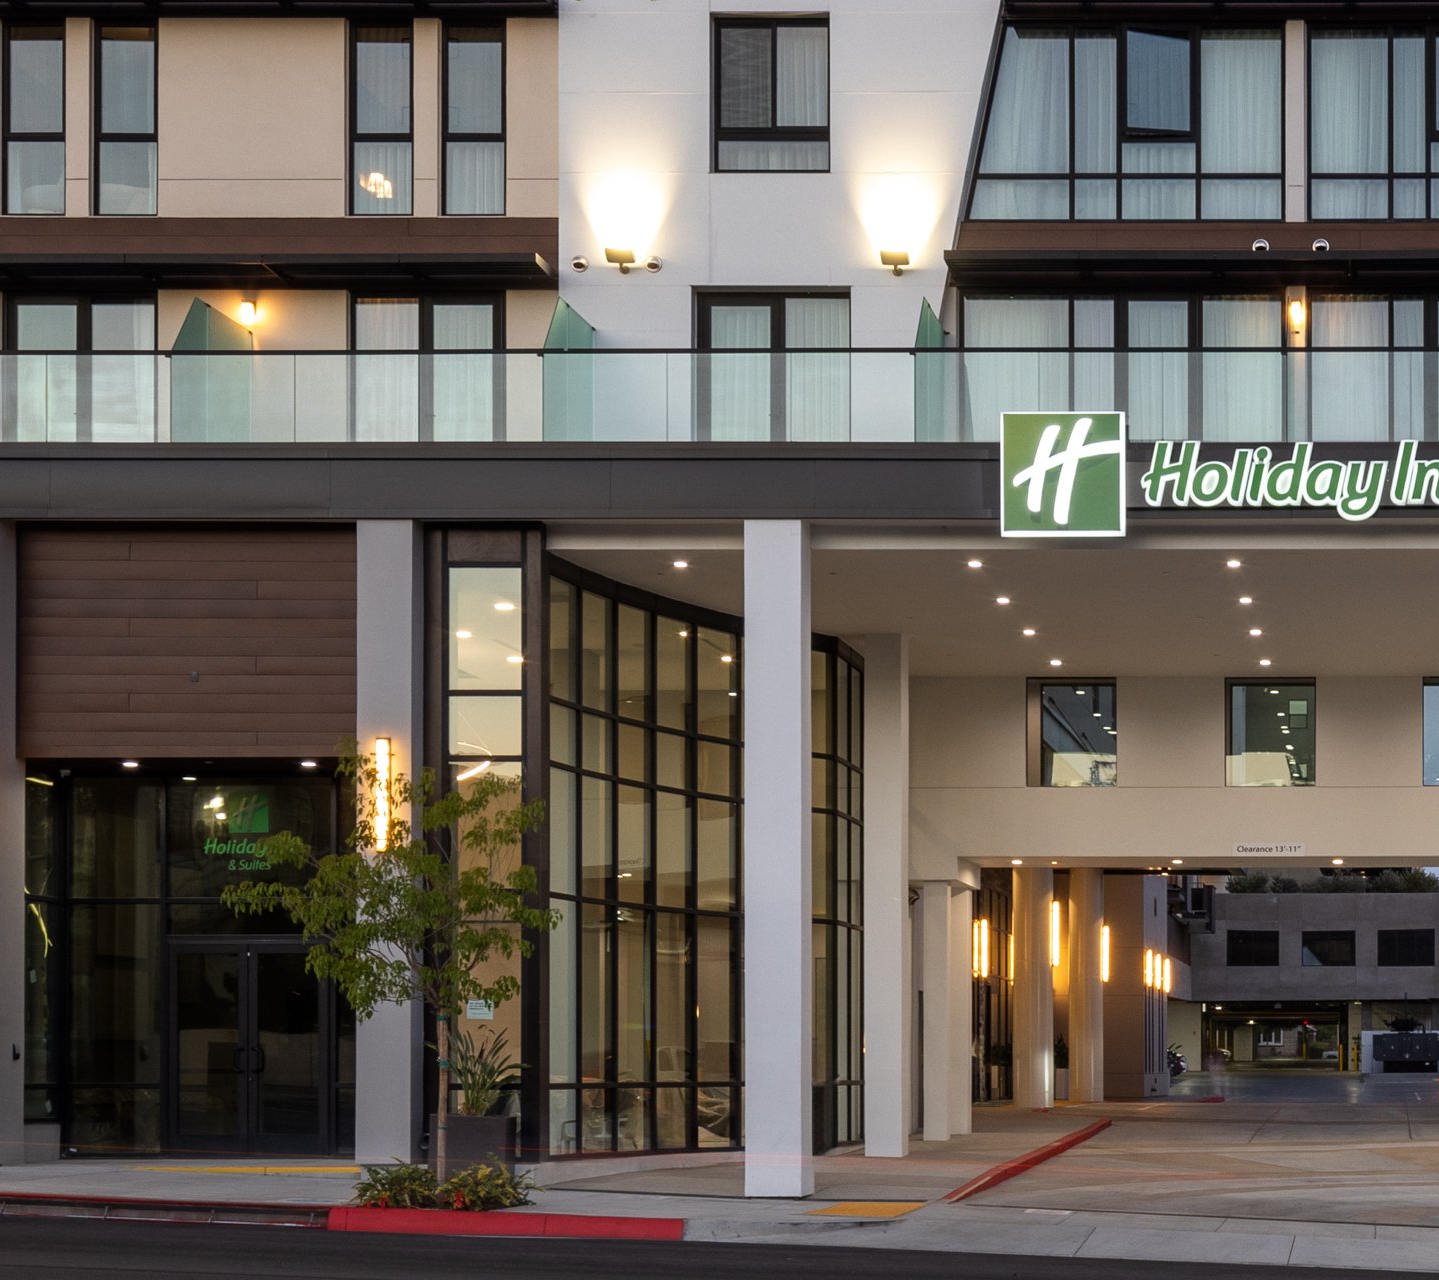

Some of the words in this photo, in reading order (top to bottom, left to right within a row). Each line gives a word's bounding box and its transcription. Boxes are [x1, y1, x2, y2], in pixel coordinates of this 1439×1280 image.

[1141, 440, 1388, 521] Holiday
[204, 837, 266, 858] Holiday
[1236, 845, 1273, 853] Clearance
[227, 859, 237, 871] &
[238, 859, 272, 871] Suites
